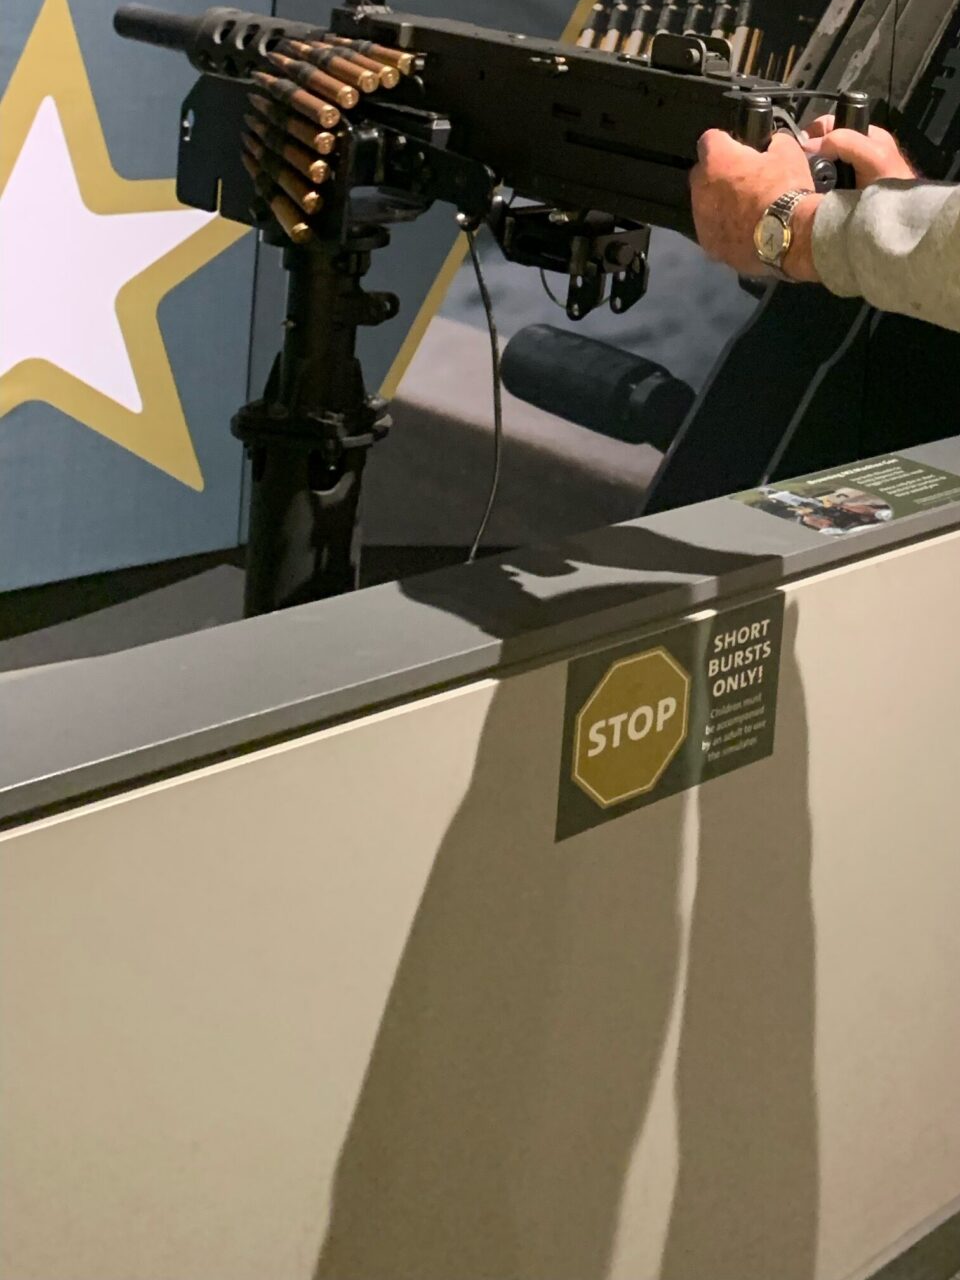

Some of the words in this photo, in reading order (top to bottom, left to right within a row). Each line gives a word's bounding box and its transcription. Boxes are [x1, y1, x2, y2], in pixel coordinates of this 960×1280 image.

[714, 619, 771, 653] SHORT
[708, 641, 772, 677] BURSTS
[712, 665, 763, 697] ONLY!
[587, 696, 677, 758] STOP
[701, 740, 711, 752] by
